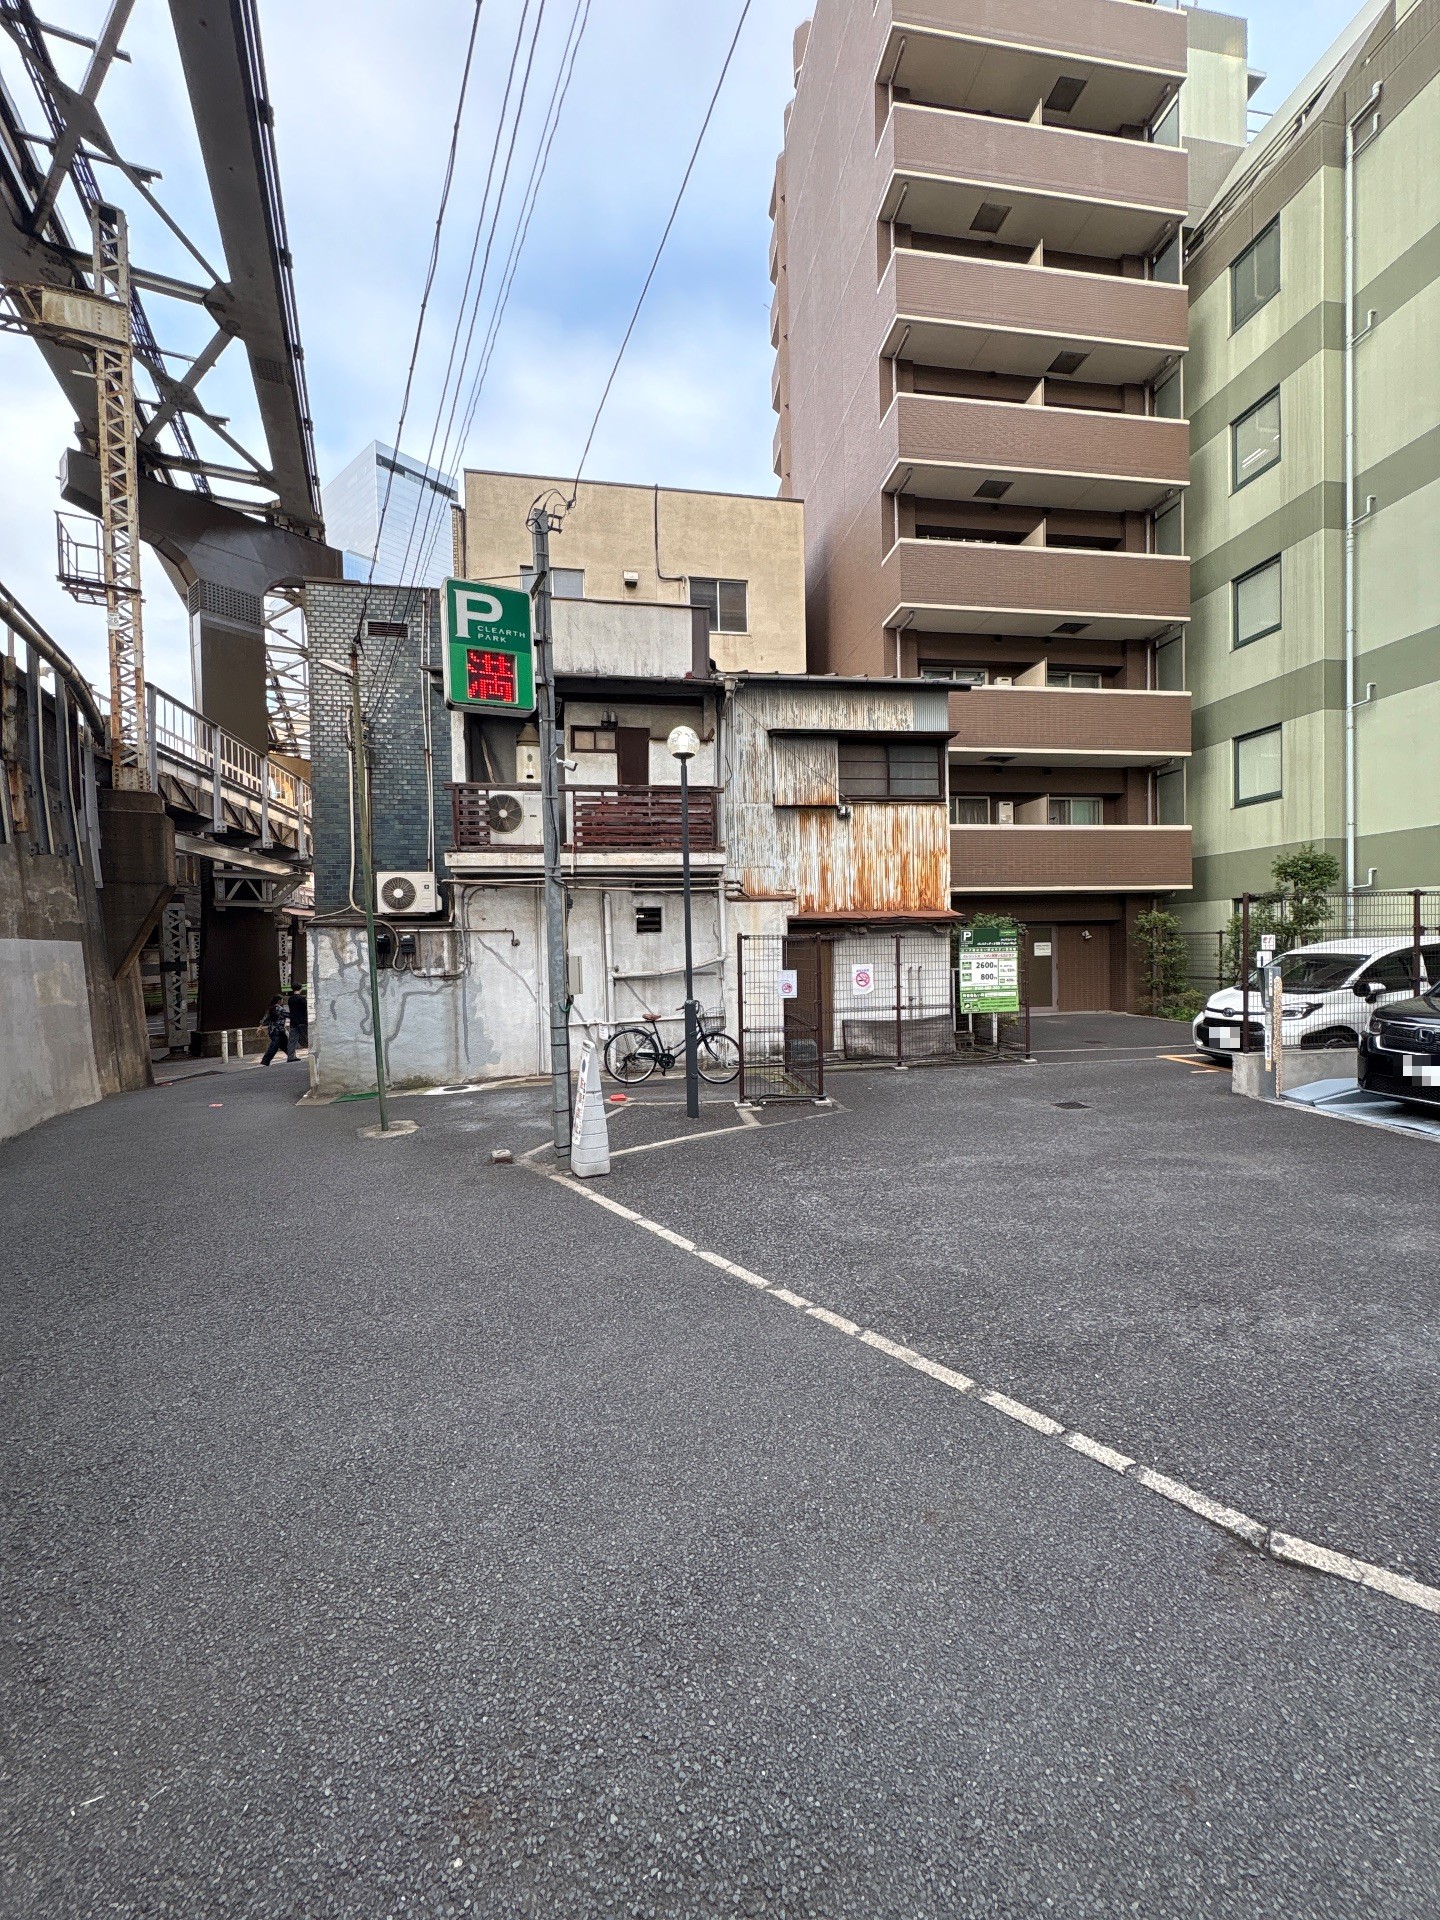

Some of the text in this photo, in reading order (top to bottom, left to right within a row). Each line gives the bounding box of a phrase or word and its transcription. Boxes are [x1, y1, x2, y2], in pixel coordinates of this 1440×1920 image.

[453, 588, 503, 639] P
[477, 625, 526, 639] CLEARTH
[477, 633, 507, 643] PARK
[963, 932, 971, 941] P
